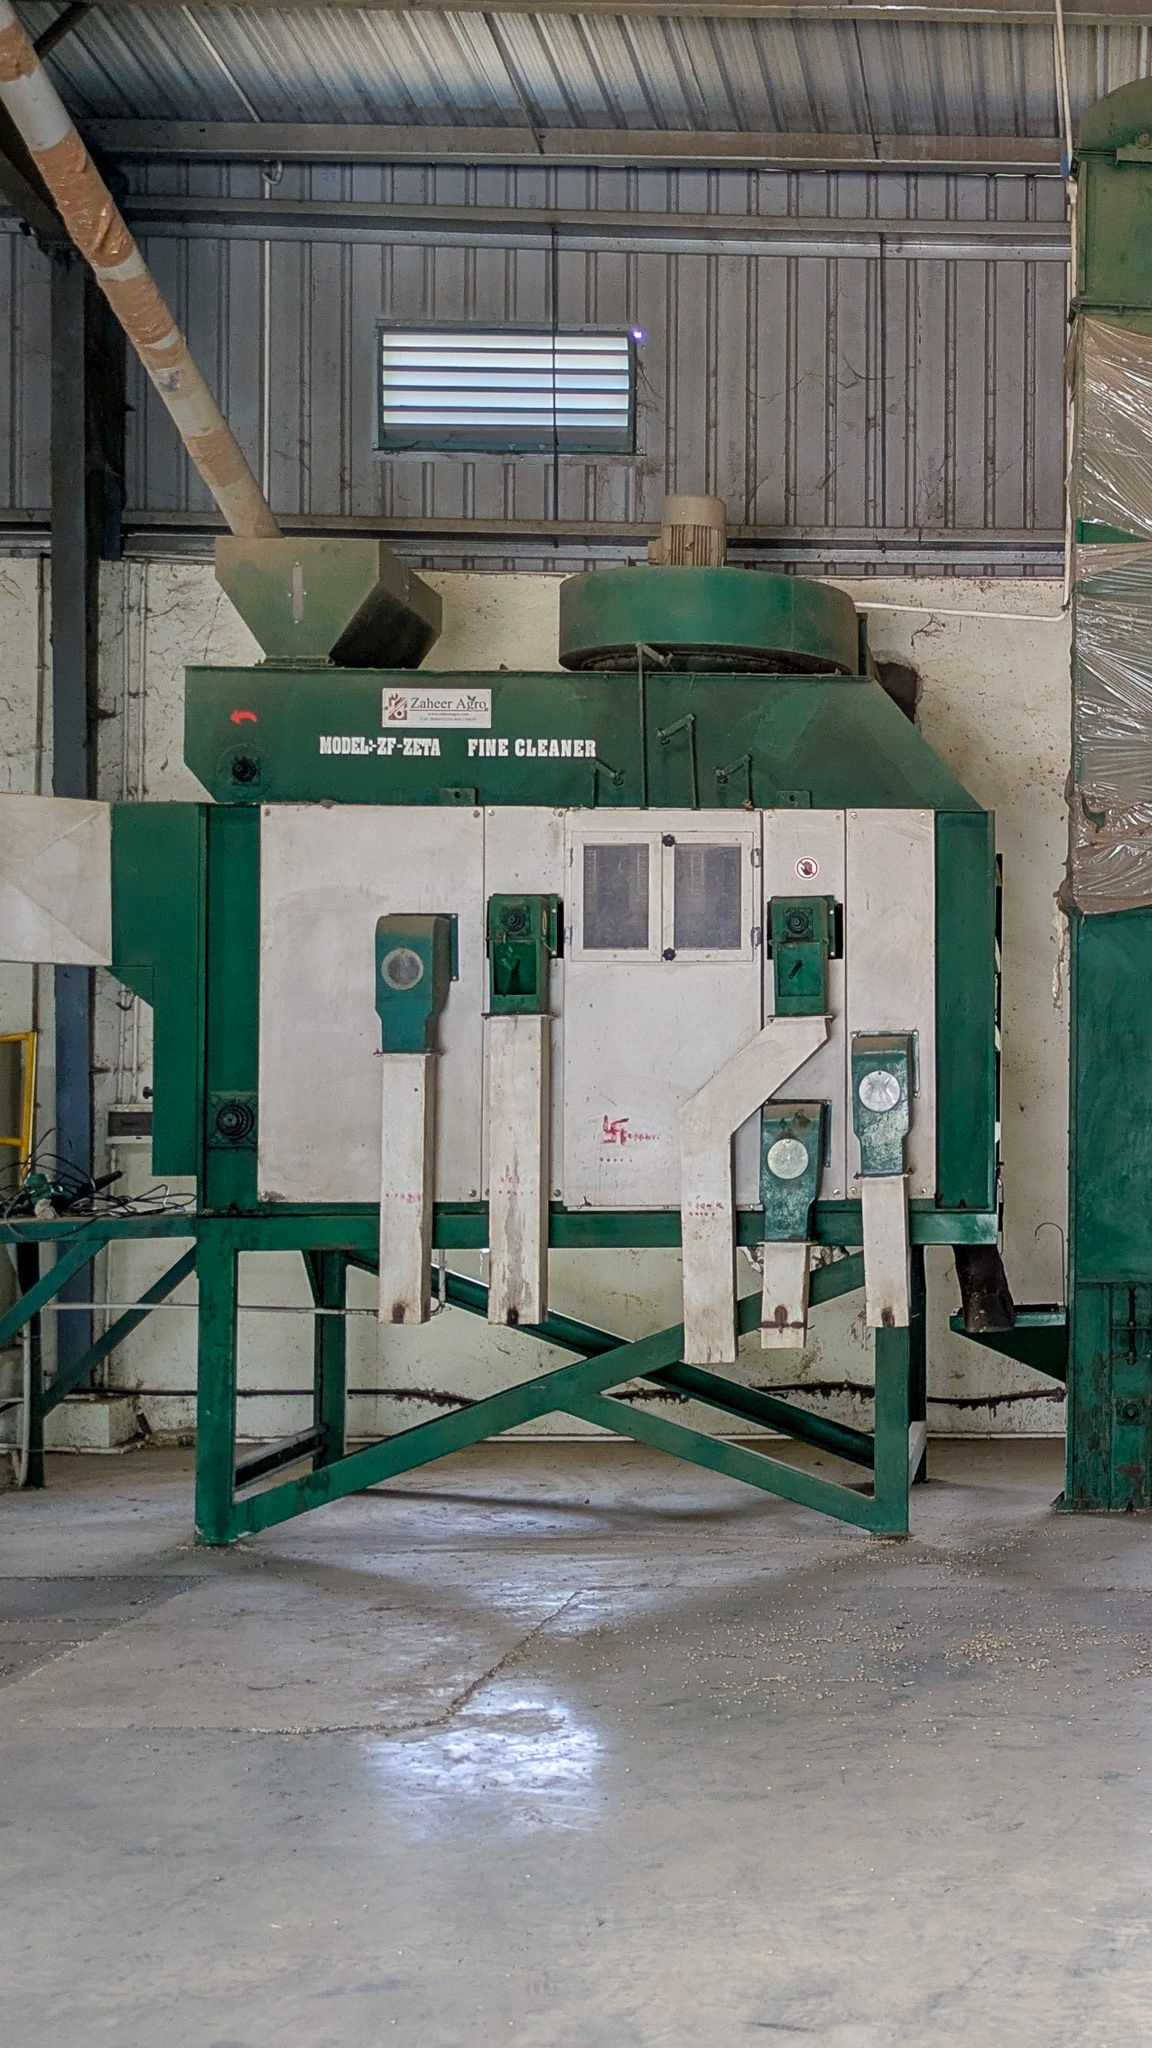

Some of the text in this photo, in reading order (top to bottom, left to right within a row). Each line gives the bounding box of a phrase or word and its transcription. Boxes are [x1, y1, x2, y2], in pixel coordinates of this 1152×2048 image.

[410, 696, 487, 711] Zaheer Agro
[467, 738, 508, 757] FINE
[514, 738, 596, 758] CLEANER
